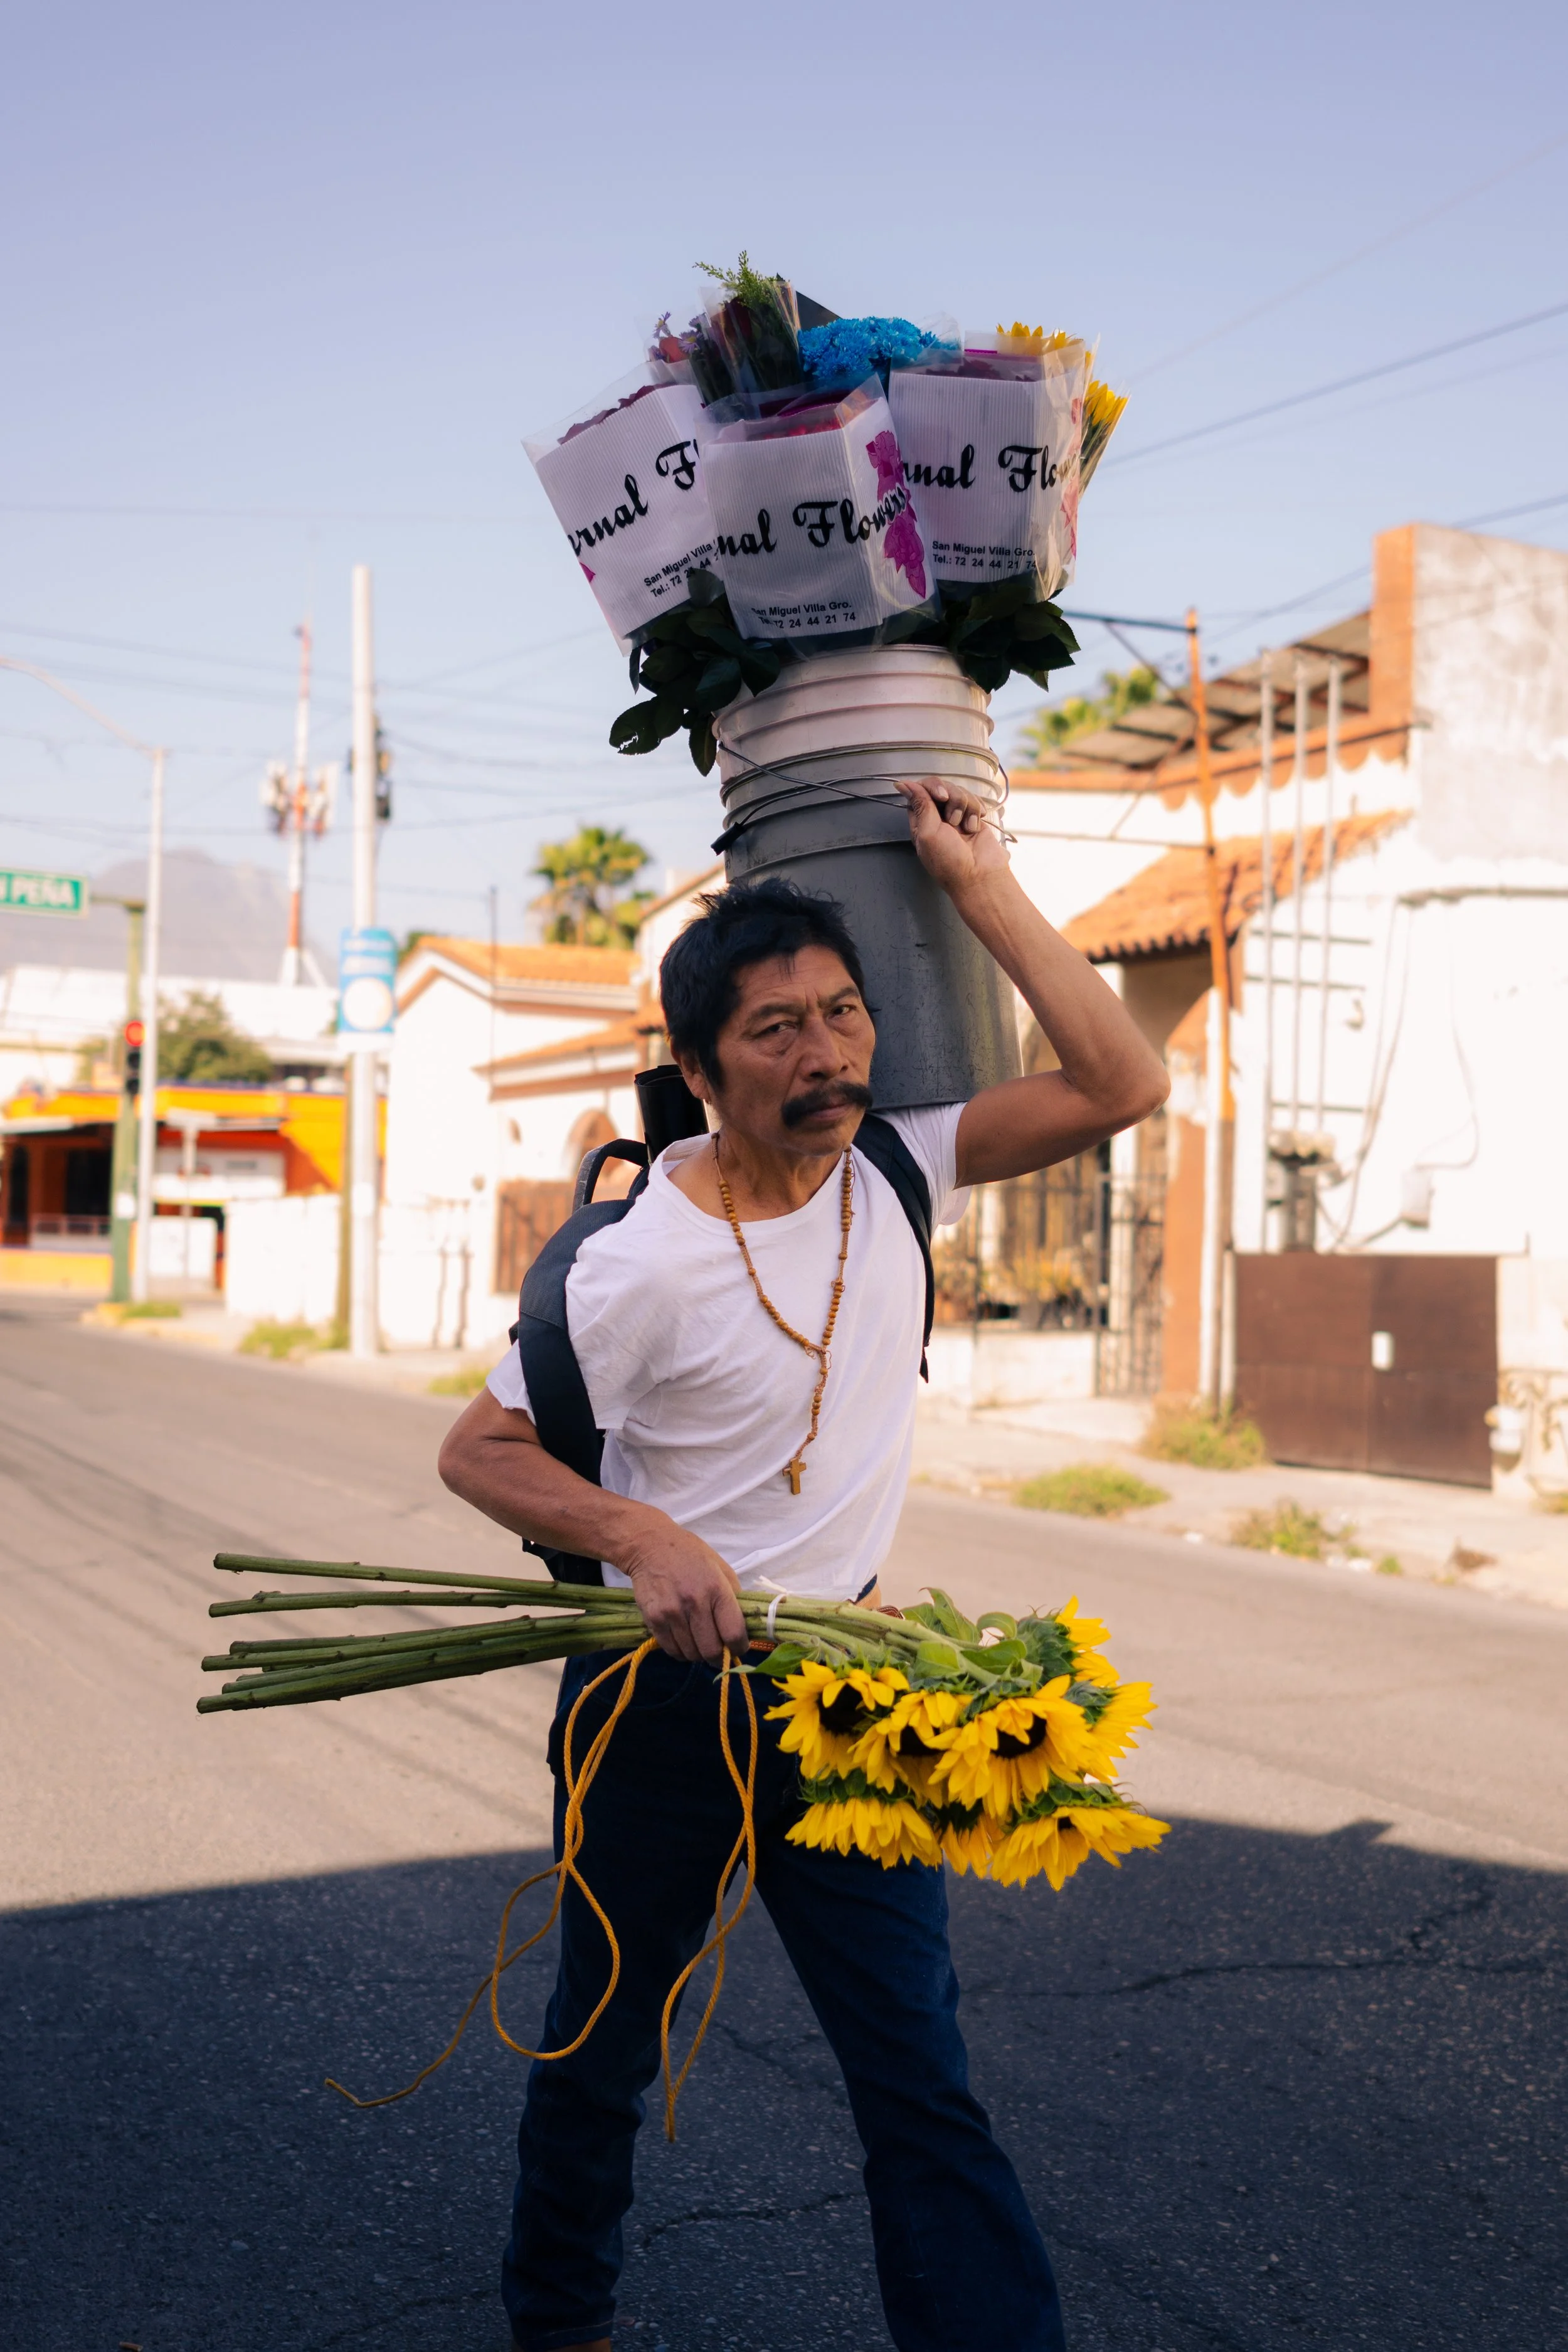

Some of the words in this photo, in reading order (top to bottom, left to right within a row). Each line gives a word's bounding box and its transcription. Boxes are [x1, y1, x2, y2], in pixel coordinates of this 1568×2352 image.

[714, 509, 778, 557] nal
[792, 487, 906, 548] Flowers
[932, 541, 950, 551] San
[953, 543, 985, 554] Miguel
[988, 546, 1010, 556] Villa
[1014, 548, 1035, 556] Gro.
[644, 573, 662, 586] San
[661, 553, 691, 576] Miguel
[690, 543, 712, 558] Villa
[933, 554, 951, 564] Tel.:
[955, 556, 966, 566] 72
[972, 558, 984, 567] 24
[988, 560, 1002, 568] 44
[1007, 561, 1019, 569] 21
[650, 583, 670, 598] Tel.:
[669, 575, 682, 586] 72
[769, 605, 801, 617] Miguel
[803, 603, 826, 613] Villa
[829, 601, 852, 610] Gro.
[788, 618, 802, 628] 24
[807, 617, 820, 626] 44
[825, 614, 837, 624] 21
[842, 612, 856, 622] 74
